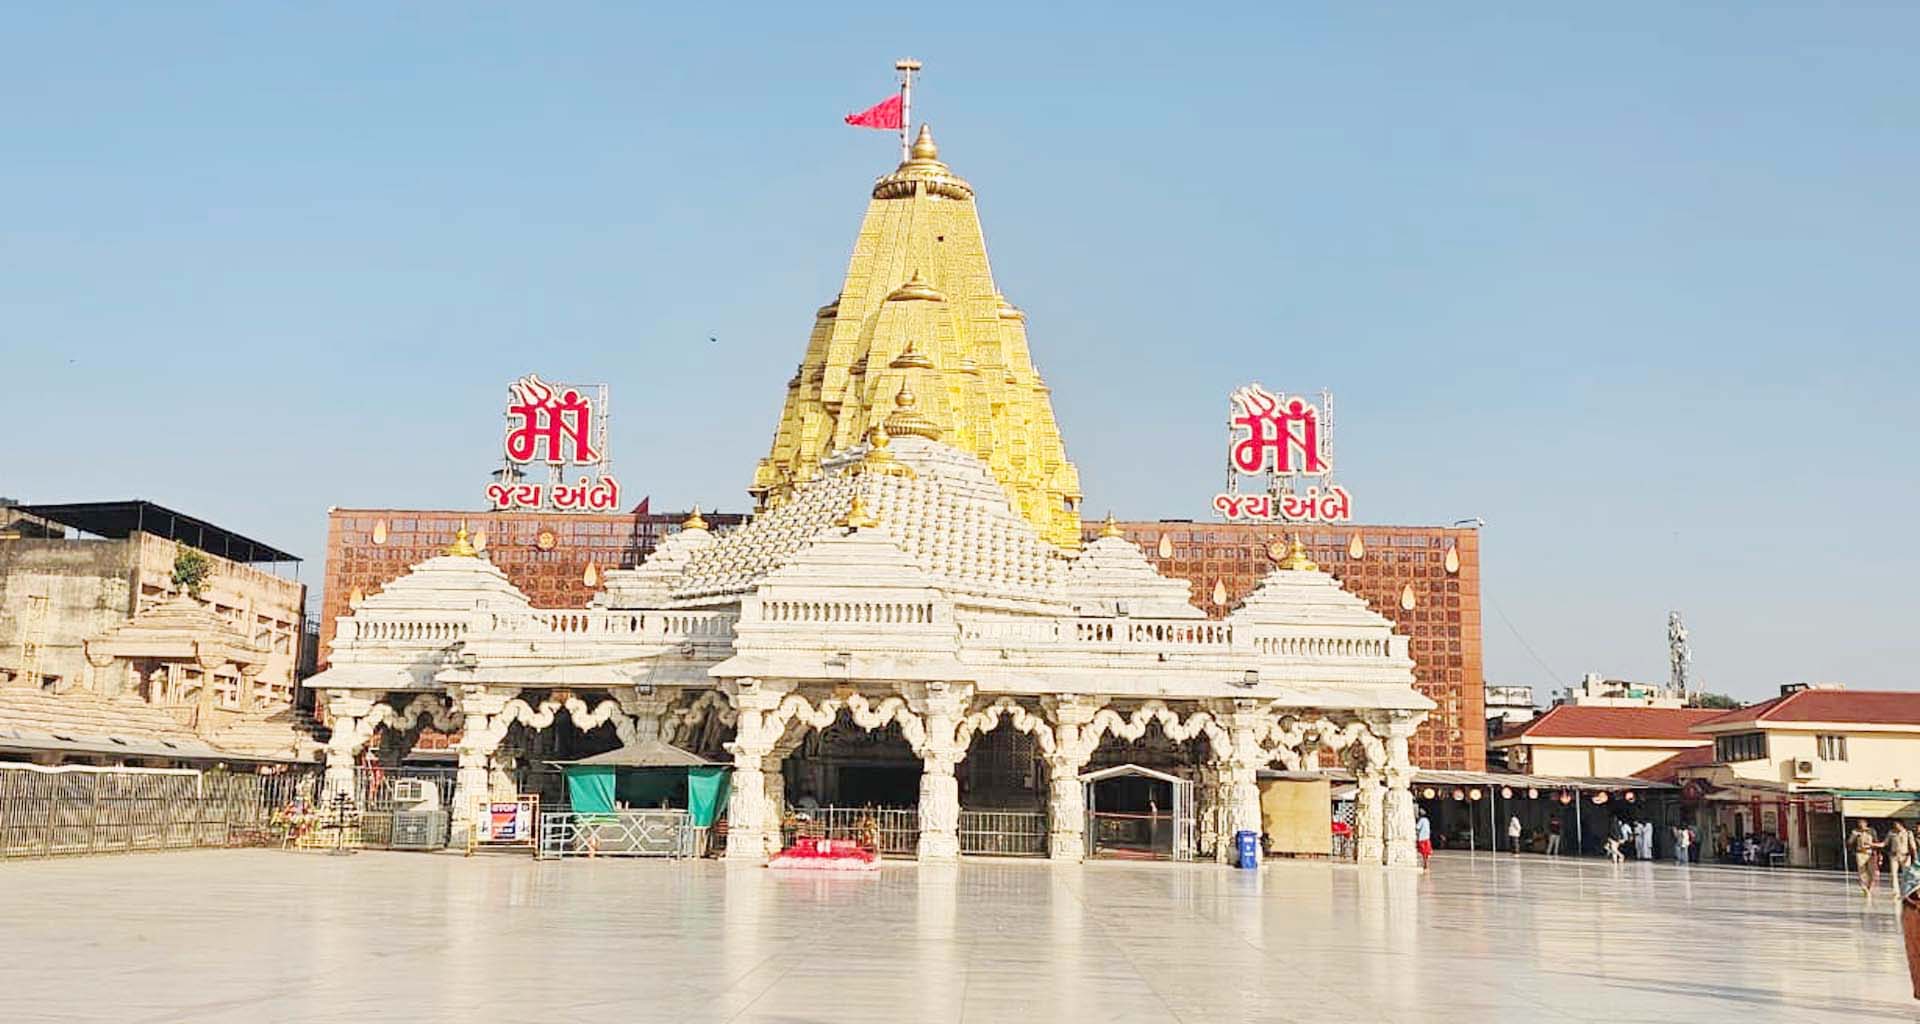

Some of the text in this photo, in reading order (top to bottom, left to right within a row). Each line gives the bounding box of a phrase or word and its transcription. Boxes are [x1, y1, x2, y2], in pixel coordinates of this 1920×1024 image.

[487, 477, 618, 508] જય અંબે
[1215, 487, 1350, 519] જય અંબે
